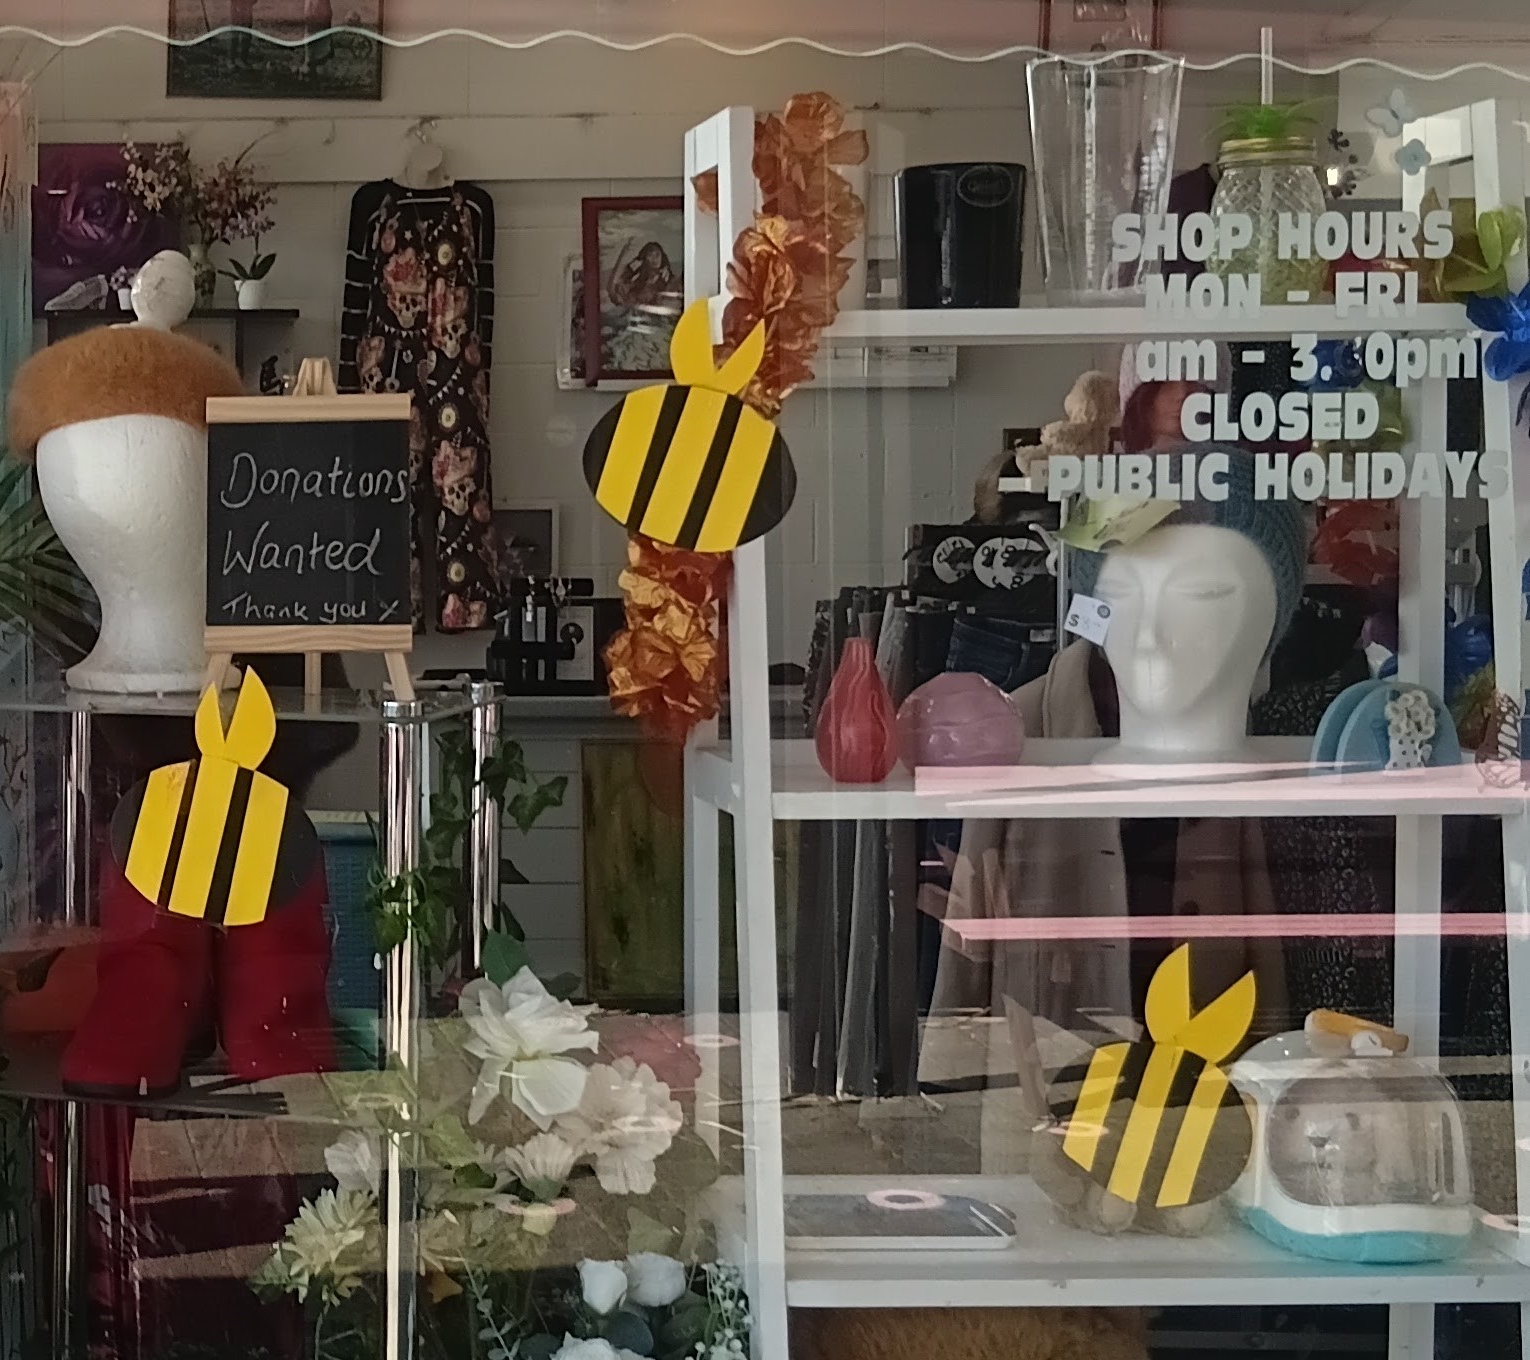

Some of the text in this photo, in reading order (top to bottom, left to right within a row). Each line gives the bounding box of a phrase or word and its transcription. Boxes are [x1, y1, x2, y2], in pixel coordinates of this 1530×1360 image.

[1111, 209, 1453, 262] SHOP HOURS
[1144, 272, 1262, 320] MON
[1334, 271, 1419, 318] FRI
[1290, 331, 1478, 388] 3.0pm
[1180, 392, 1380, 442] CLOSED
[220, 451, 409, 509] Donations
[1047, 449, 1510, 502] PUBLIC HOLIDAYS
[222, 520, 384, 576] Wanted
[222, 591, 310, 622] Thank
[319, 600, 367, 624] you
